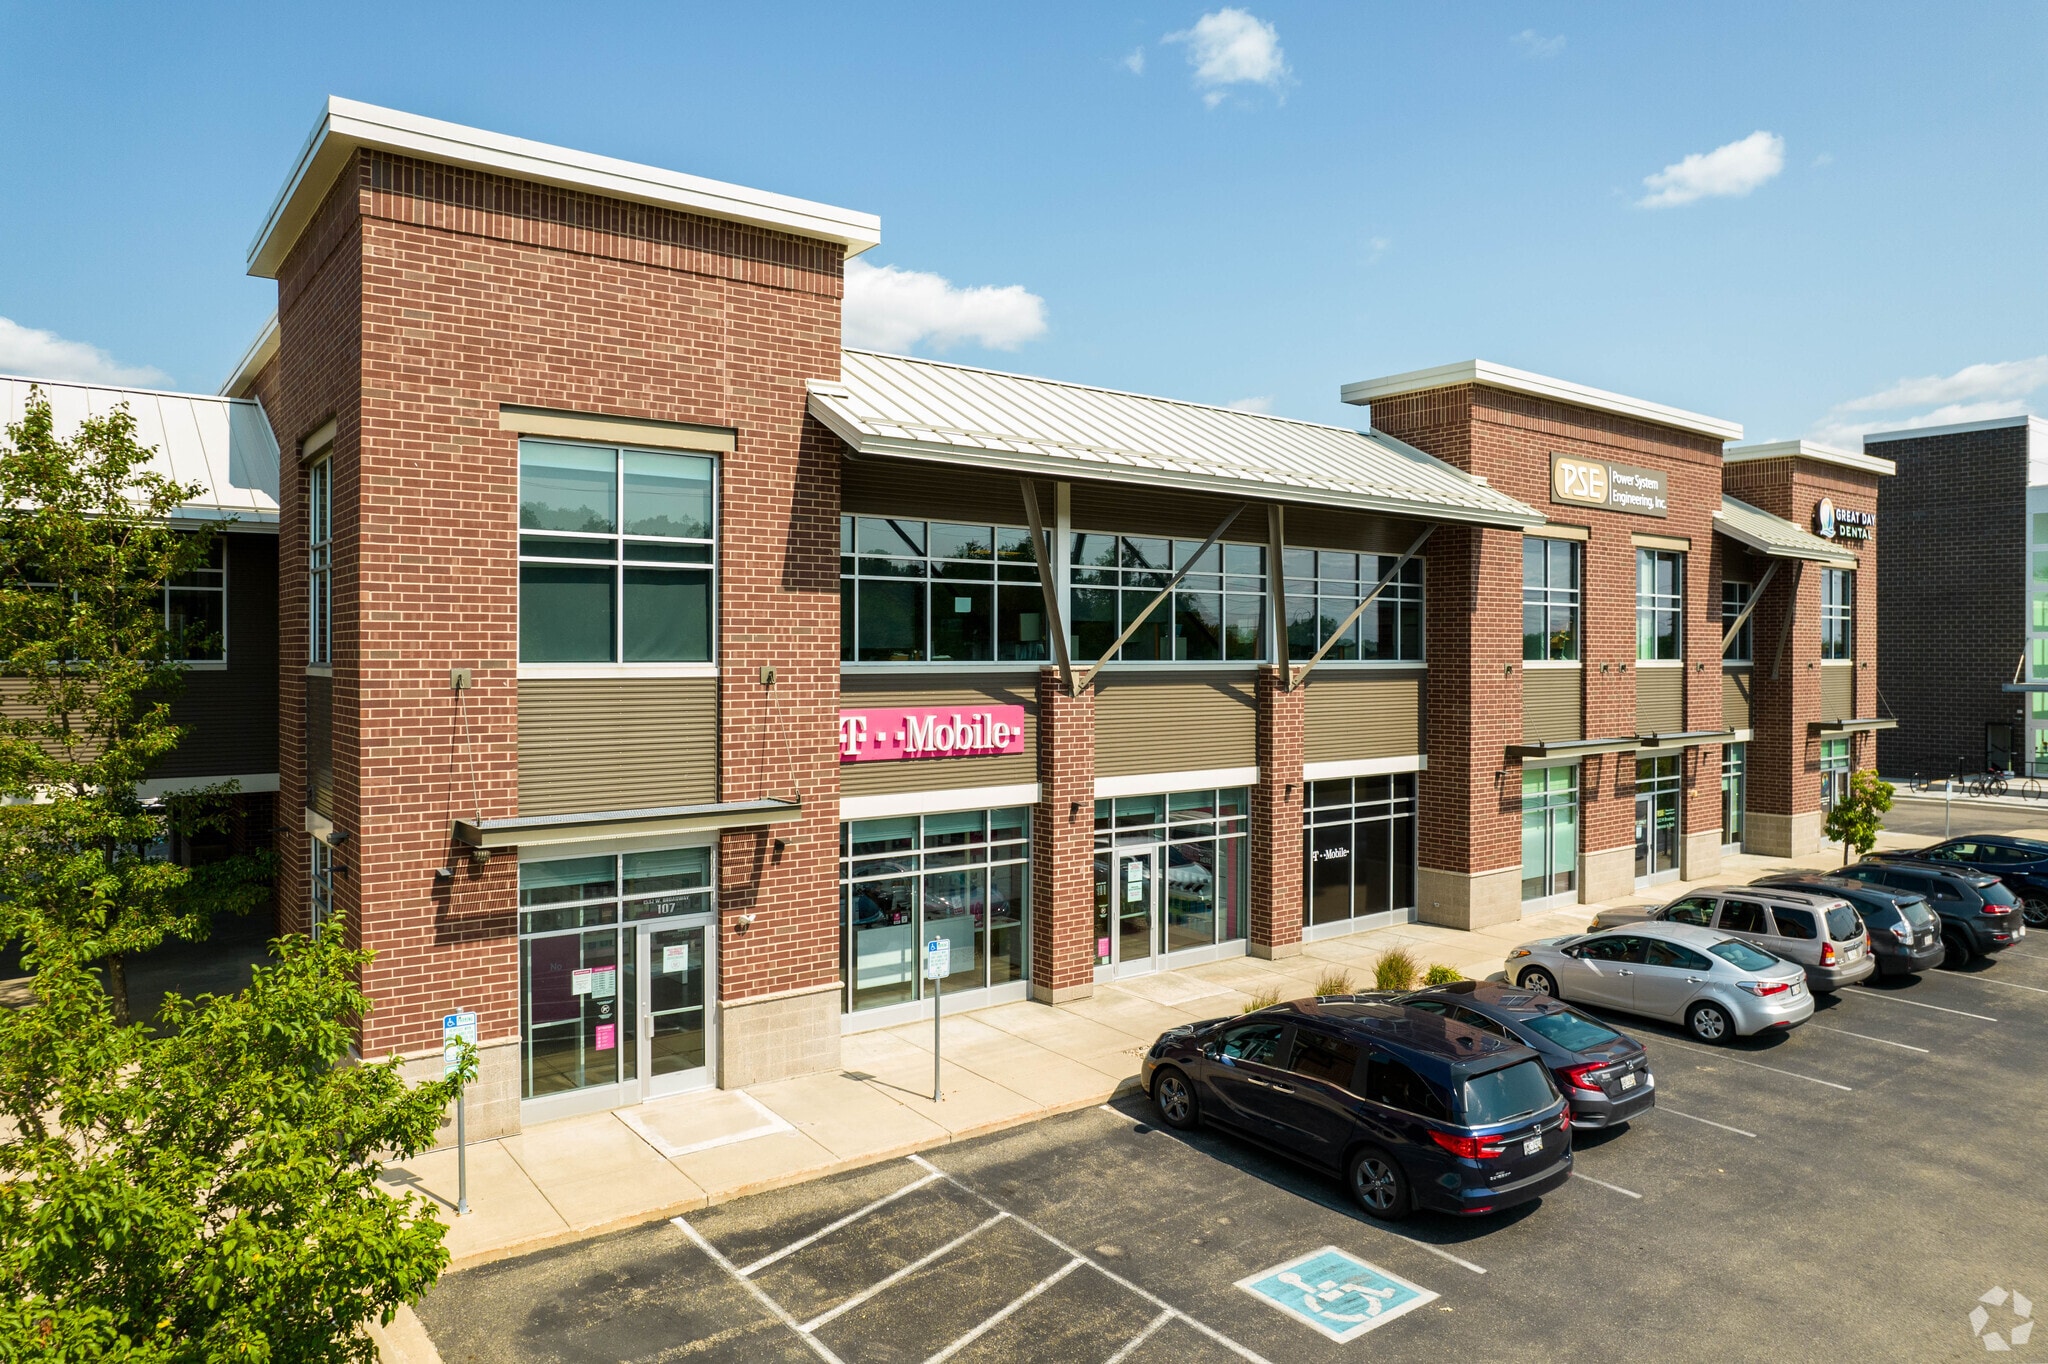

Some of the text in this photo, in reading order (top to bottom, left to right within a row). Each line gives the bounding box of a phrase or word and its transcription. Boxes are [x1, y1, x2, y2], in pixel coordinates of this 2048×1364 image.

[1560, 463, 1604, 499] PSE
[1612, 471, 1659, 490] Power System
[1612, 490, 1667, 510] Engineering, Inc.
[1836, 508, 1876, 526] GREAT DAY
[1840, 525, 1873, 540] DENTAL
[657, 902, 676, 914] 107
